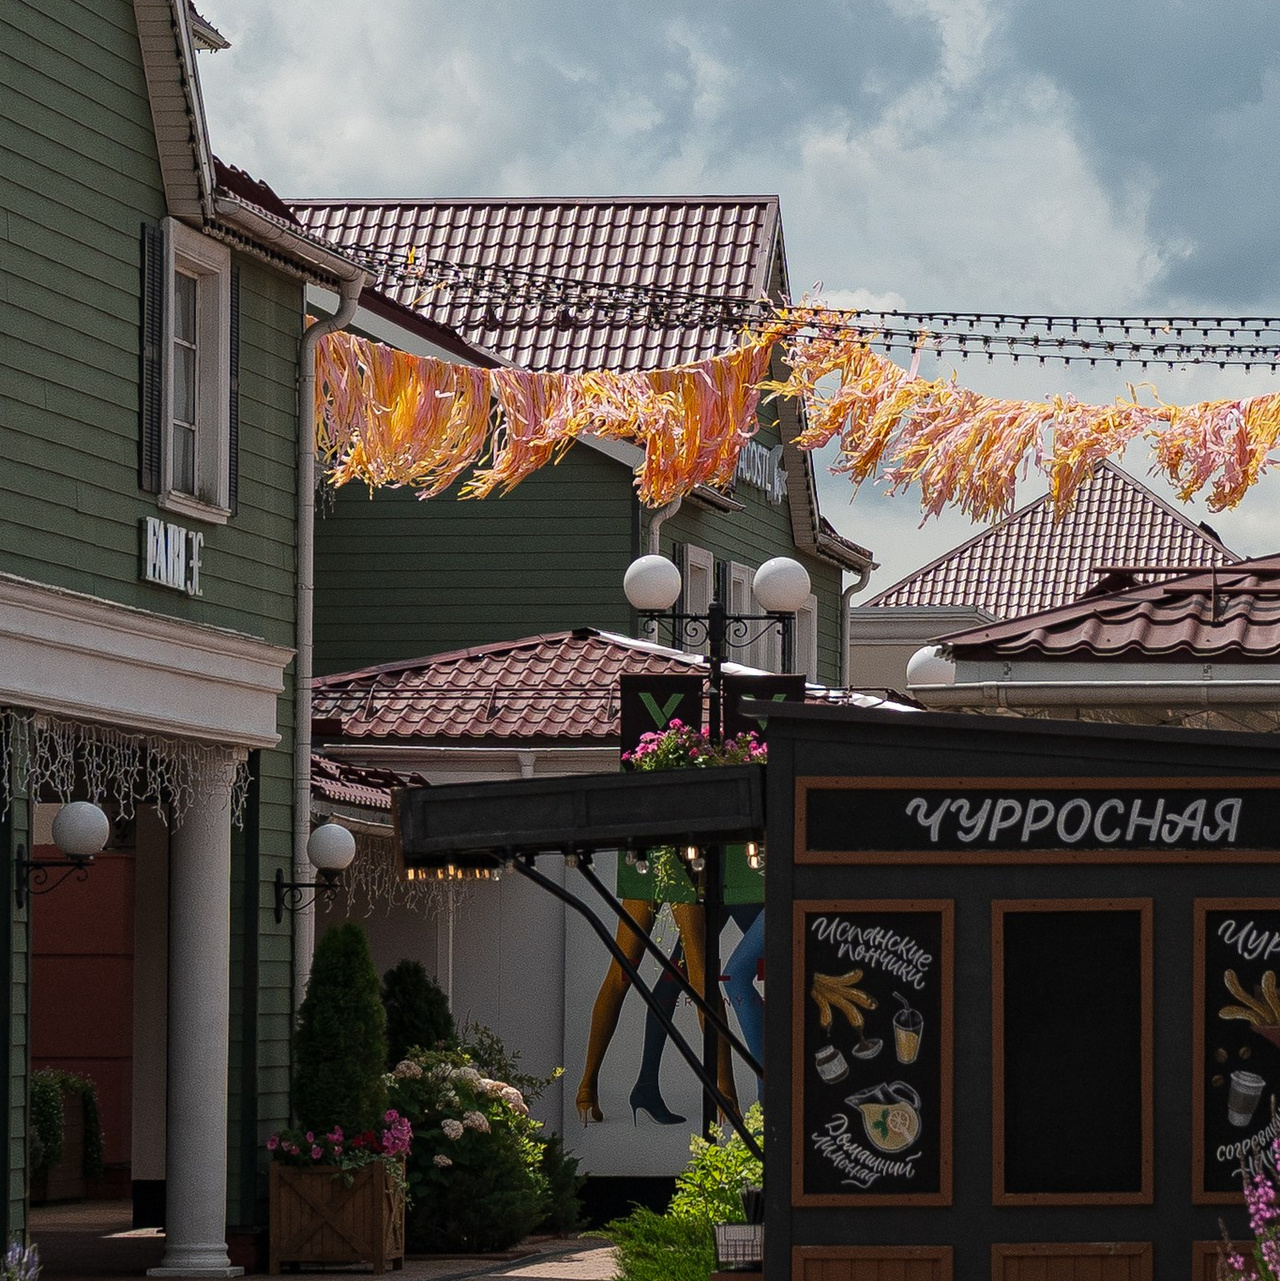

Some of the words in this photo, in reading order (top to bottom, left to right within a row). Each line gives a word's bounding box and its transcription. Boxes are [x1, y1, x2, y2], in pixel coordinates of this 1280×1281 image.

[905, 797, 1243, 843] ЧУРРОСНАЯ
[811, 916, 933, 971] Испанские
[837, 942, 926, 990] пончики
[811, 1132, 881, 1188] лимонад
[824, 1113, 922, 1178] Домашний
